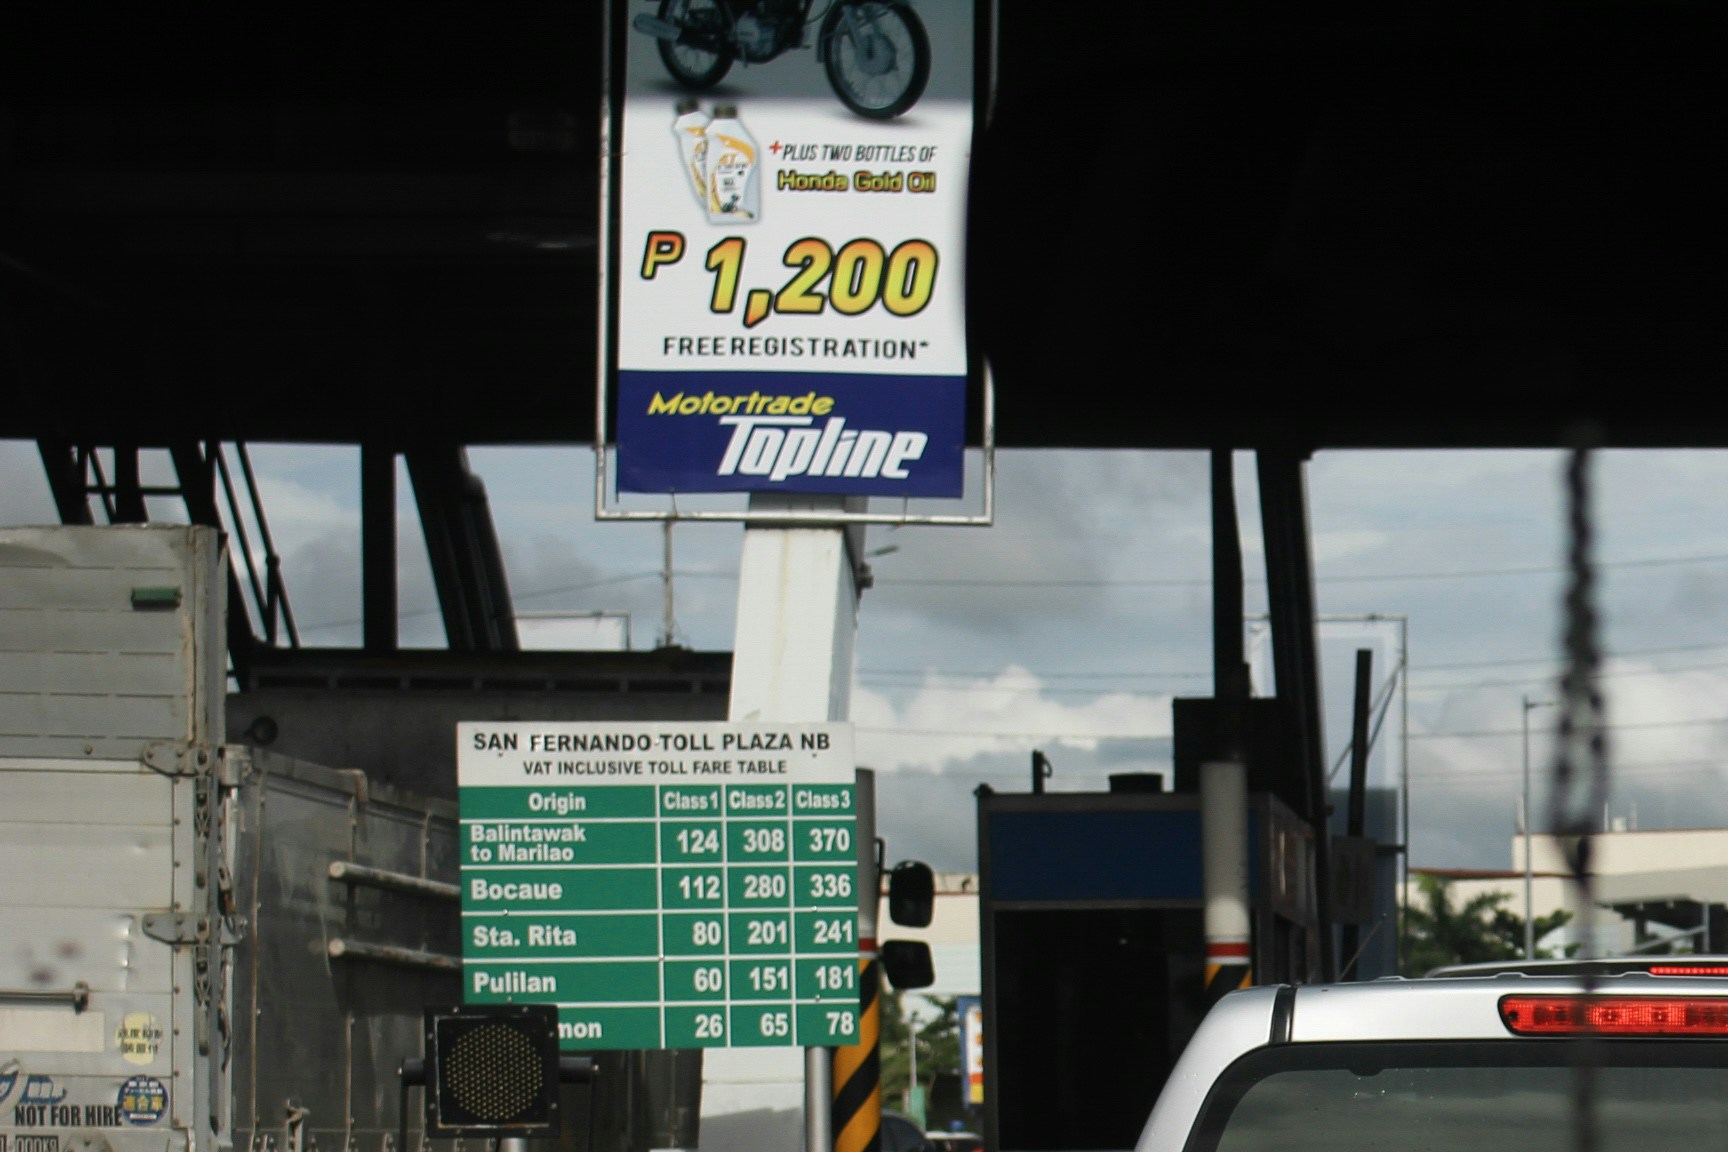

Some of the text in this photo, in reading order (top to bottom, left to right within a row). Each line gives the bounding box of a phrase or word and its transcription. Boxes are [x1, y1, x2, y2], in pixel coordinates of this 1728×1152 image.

[821, 144, 853, 163] TWO
[855, 144, 916, 163] BOTTLES
[919, 145, 938, 163] OF
[776, 169, 936, 193] Honda Gold Oil
[640, 230, 938, 329] P 1,200
[647, 390, 835, 416] Motortrade
[716, 415, 928, 482] Topline
[474, 733, 829, 751] SAN FERNANDO TOLL PLAZA NB
[524, 761, 785, 774] VAT INCLUSIVE TOLL FARE TABLE
[529, 793, 585, 815] Origin
[470, 823, 587, 842] Balintawak
[677, 830, 719, 853] 124
[744, 829, 784, 852] 308
[810, 828, 849, 851] 370
[471, 844, 573, 861] to Marilao
[471, 879, 562, 899] Bocaue
[680, 876, 720, 898] 112
[745, 875, 785, 898] 280
[811, 874, 851, 897] 336
[474, 926, 576, 946] Sta. Rita
[693, 922, 720, 945] 80
[748, 921, 786, 944] 201
[814, 920, 852, 943] 241
[474, 972, 555, 992] Pulilan
[694, 968, 721, 991] 60
[750, 967, 787, 990] 151
[816, 966, 853, 989] 181
[696, 1014, 722, 1037] 26
[761, 1013, 788, 1036] 65
[827, 1012, 853, 1035] 78
[14, 1104, 123, 1127] NOT FOR HIRE
